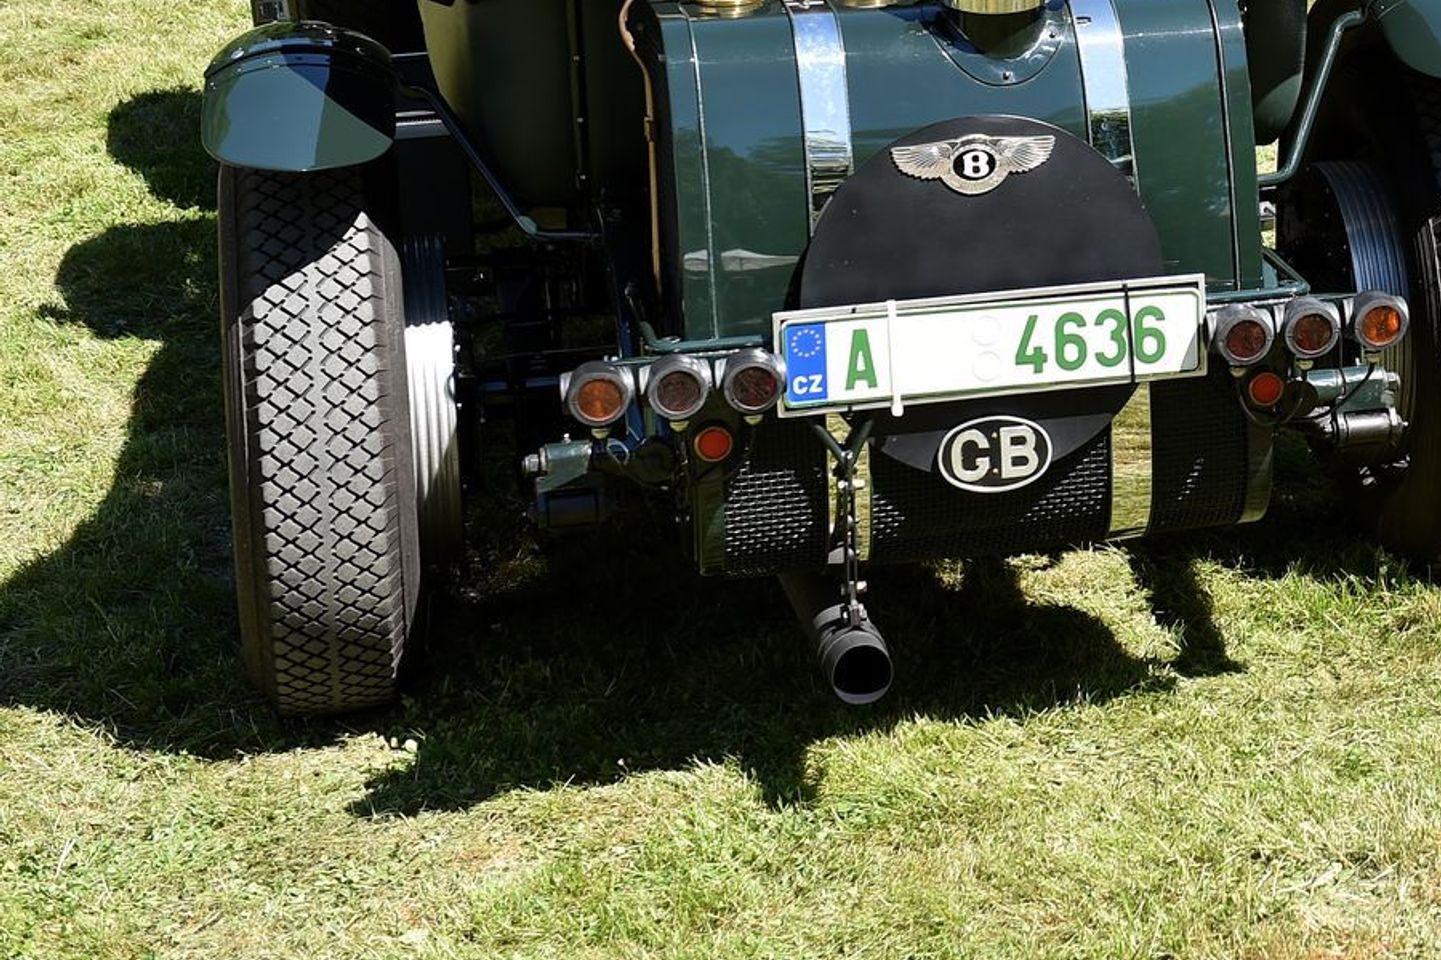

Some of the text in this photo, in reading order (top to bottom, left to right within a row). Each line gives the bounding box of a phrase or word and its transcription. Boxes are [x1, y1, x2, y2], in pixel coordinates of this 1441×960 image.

[962, 151, 990, 178] B
[844, 305, 1166, 391] A 4636
[793, 375, 823, 394] CZ
[950, 424, 1040, 482] GB
